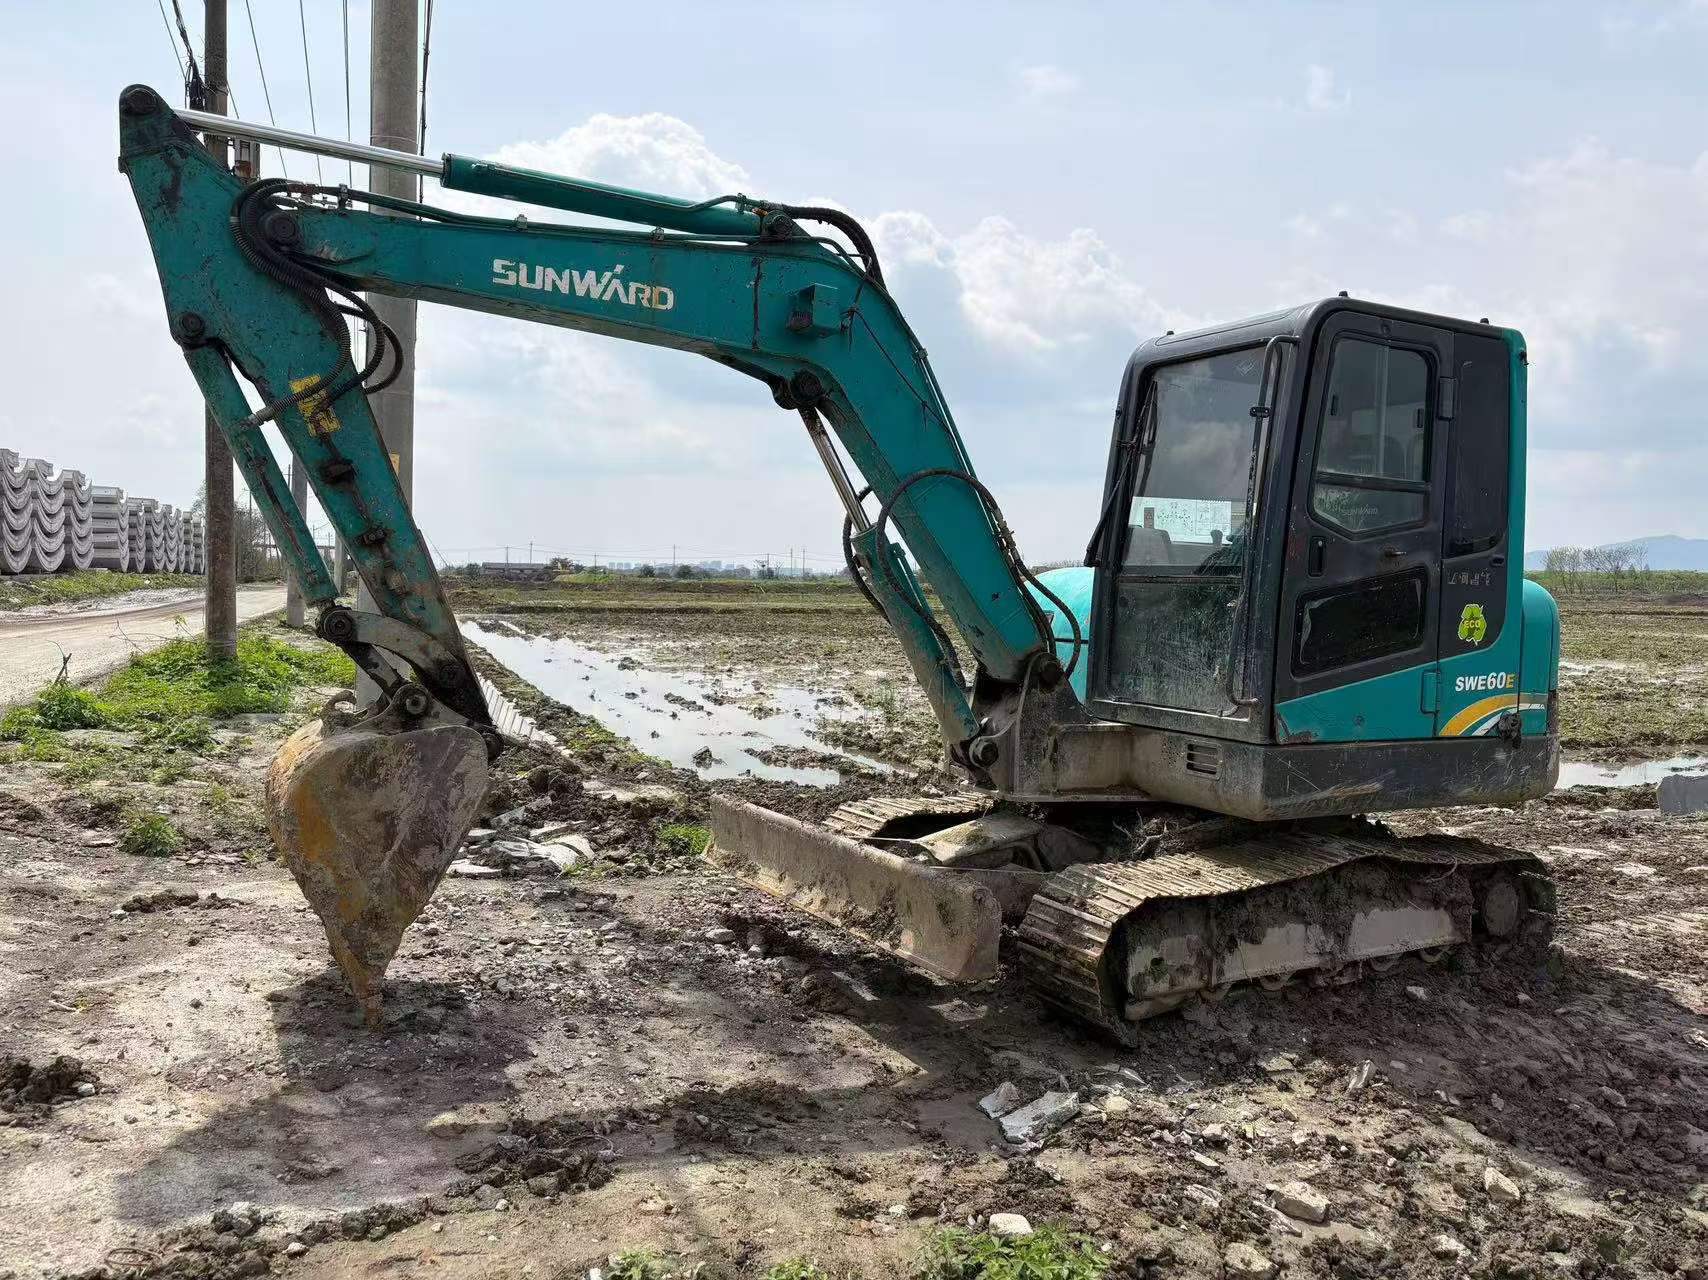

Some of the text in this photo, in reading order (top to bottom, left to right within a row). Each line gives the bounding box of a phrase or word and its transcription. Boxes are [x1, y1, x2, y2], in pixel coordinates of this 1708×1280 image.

[492, 258, 674, 310] SUNWARD
[1464, 620, 1481, 628] ECO
[1455, 672, 1515, 691] SWE60E
